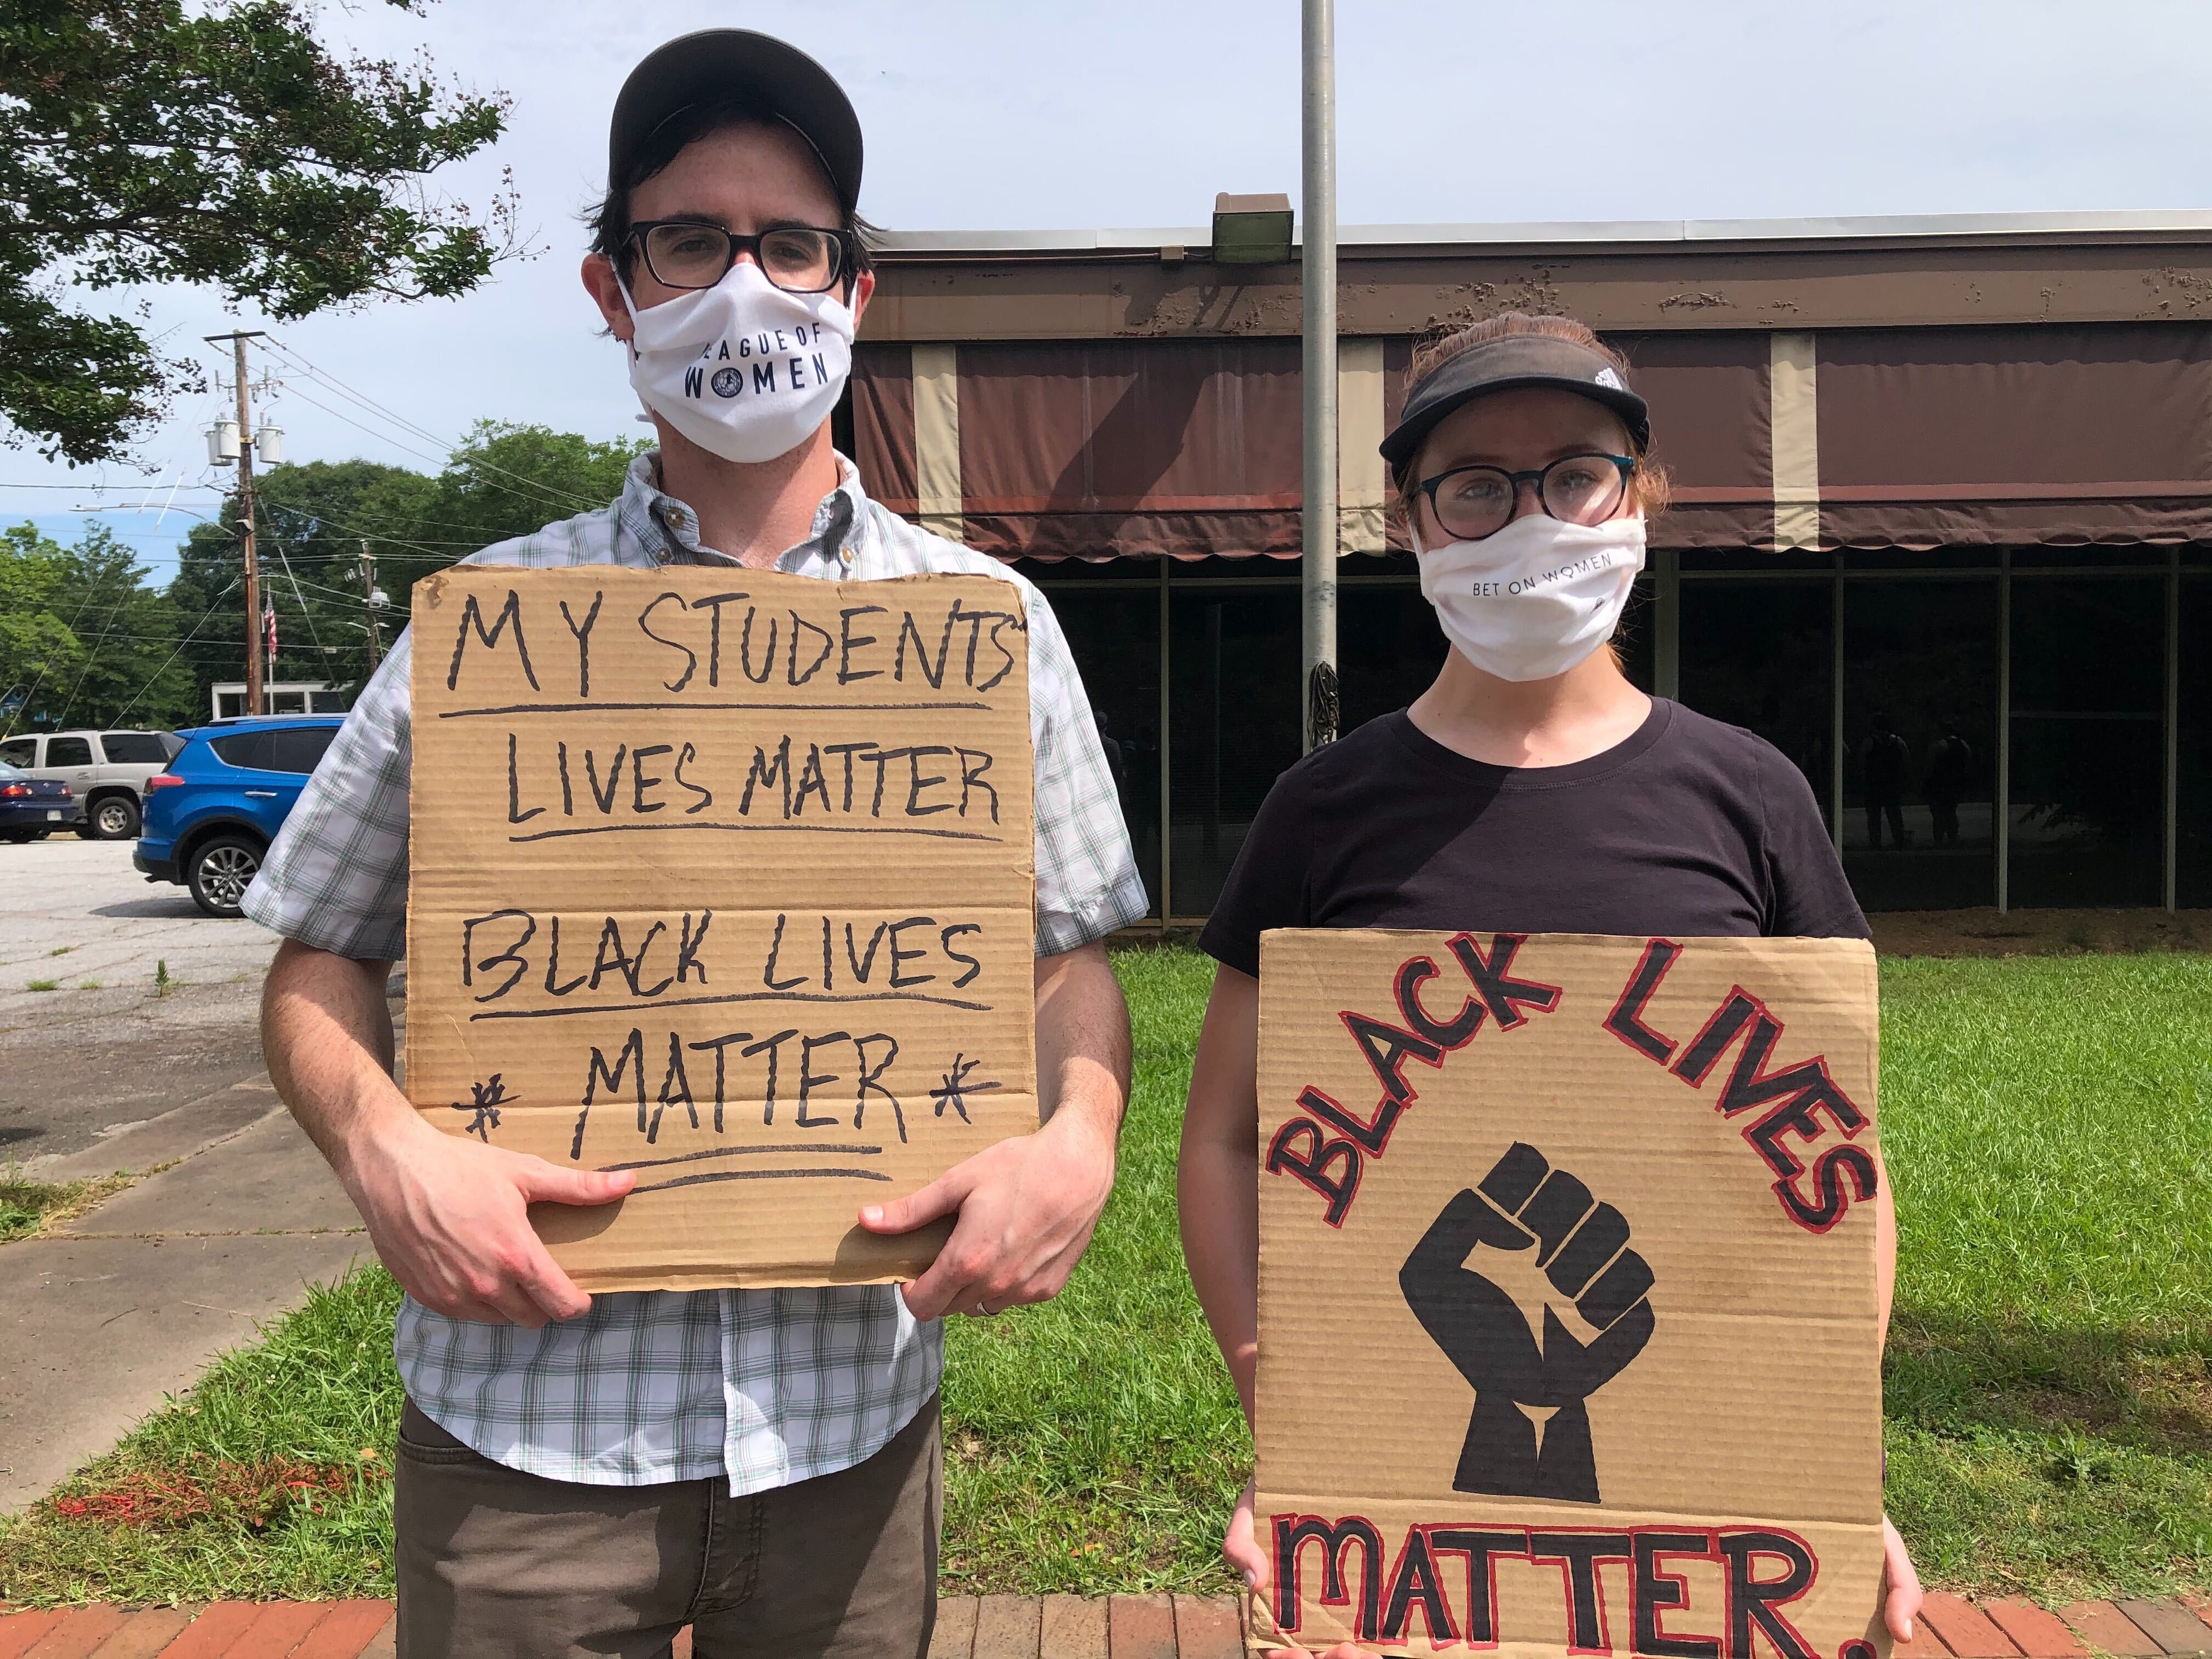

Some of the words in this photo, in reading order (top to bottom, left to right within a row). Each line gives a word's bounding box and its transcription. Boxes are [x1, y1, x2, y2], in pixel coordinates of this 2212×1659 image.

[796, 323, 820, 346] OF
[1473, 582, 1499, 596] BET
[1509, 577, 1536, 594] ON
[1542, 552, 1611, 582] WOMEN
[448, 589, 603, 698] MY
[638, 592, 1027, 692] STUDENTS
[509, 733, 712, 823] LIVES
[738, 734, 999, 825] MATTER
[463, 908, 713, 1002] BLACK
[764, 914, 982, 990] LIVES
[570, 1028, 908, 1161] MATTER
[1266, 932, 1563, 1228] BLACK
[1602, 938, 1877, 1233] LIVES
